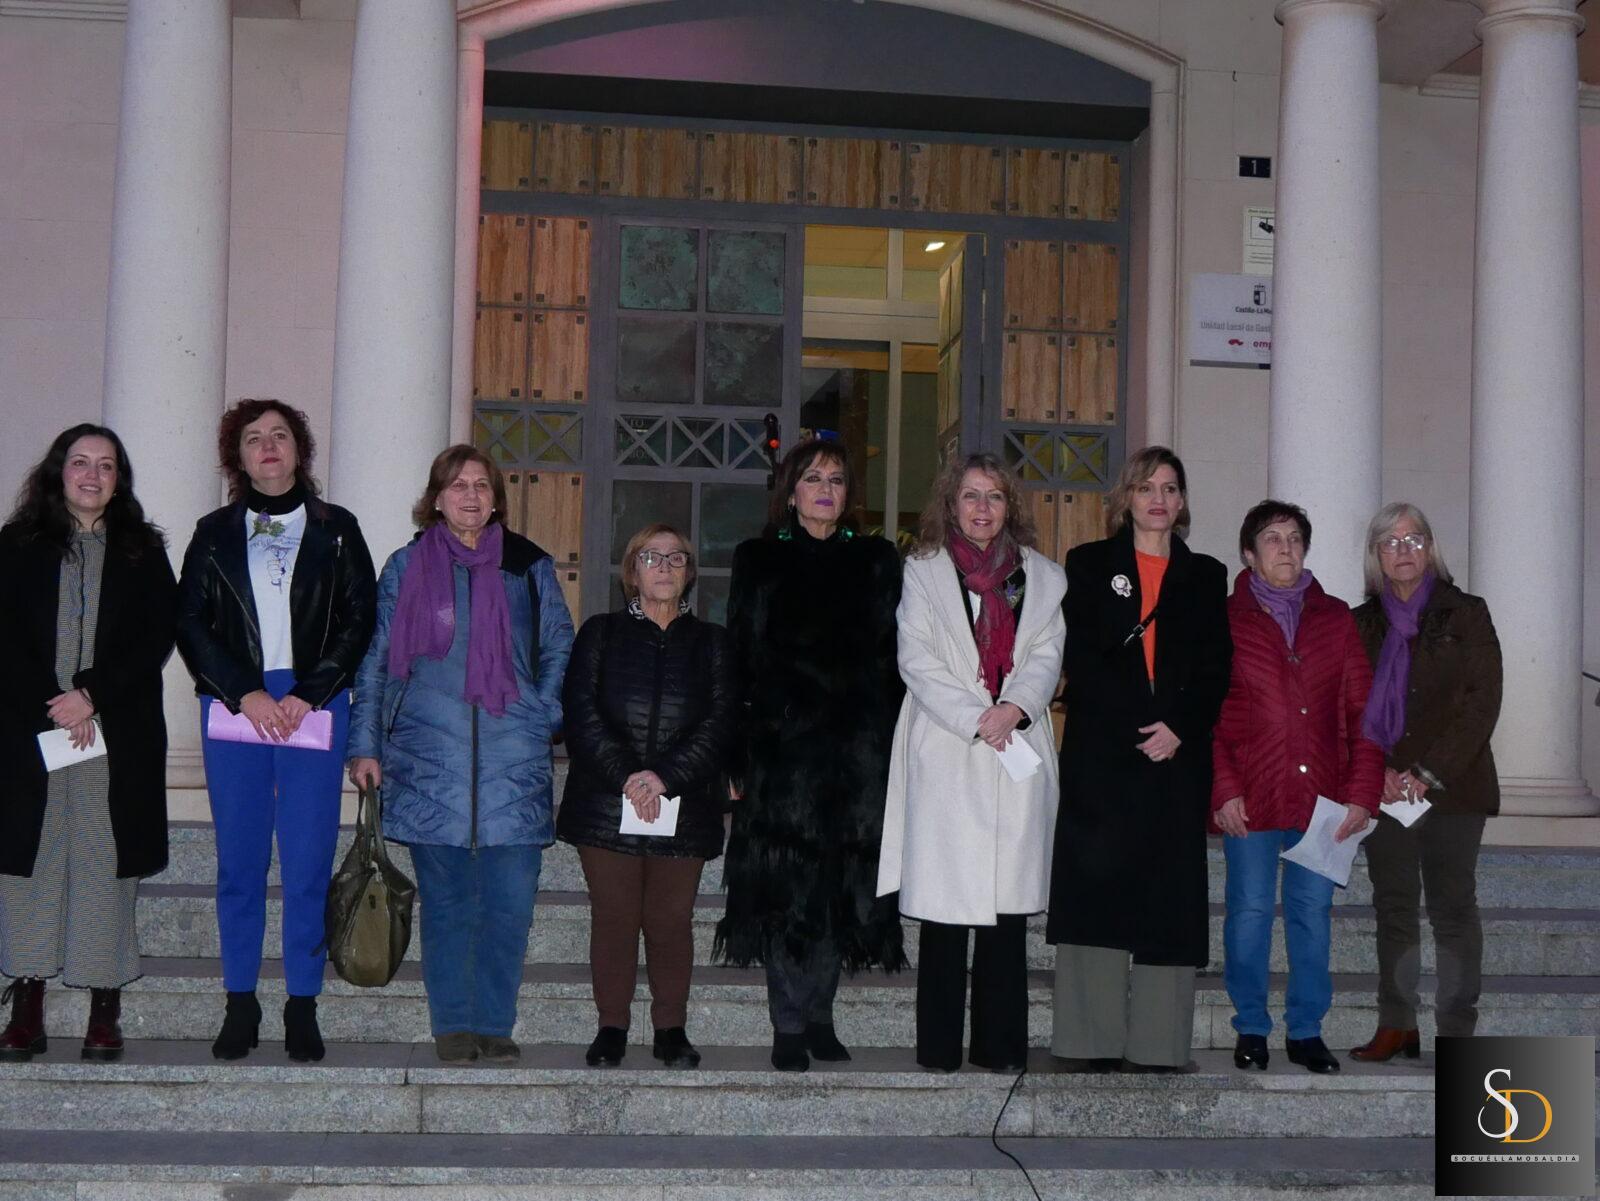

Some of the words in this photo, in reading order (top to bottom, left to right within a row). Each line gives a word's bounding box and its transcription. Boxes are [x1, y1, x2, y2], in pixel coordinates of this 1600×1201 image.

[1251, 160, 1257, 175] 1
[1201, 321, 1225, 330] Unidad
[1226, 322, 1243, 331] Local
[1246, 323, 1254, 331] de
